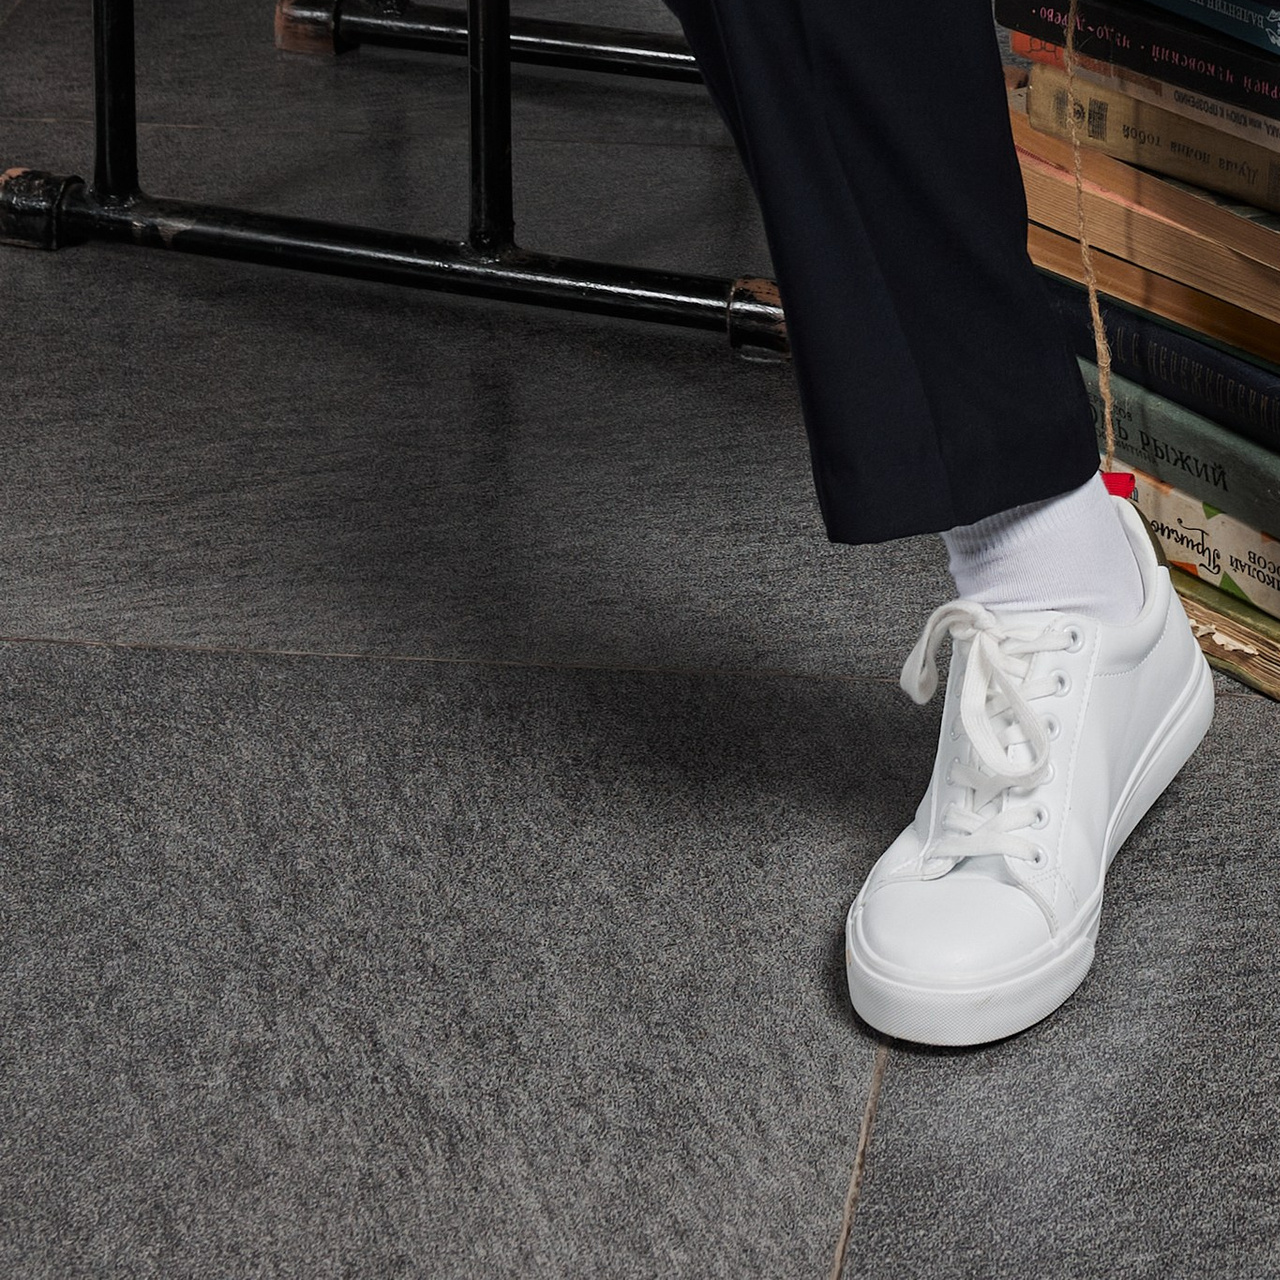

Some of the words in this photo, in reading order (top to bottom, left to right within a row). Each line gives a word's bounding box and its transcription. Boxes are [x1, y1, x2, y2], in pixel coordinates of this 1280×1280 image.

[1118, 123, 1163, 149] тобой
[1215, 156, 1260, 185] Душа
[1139, 429, 1228, 492] РЫЖИЙ
